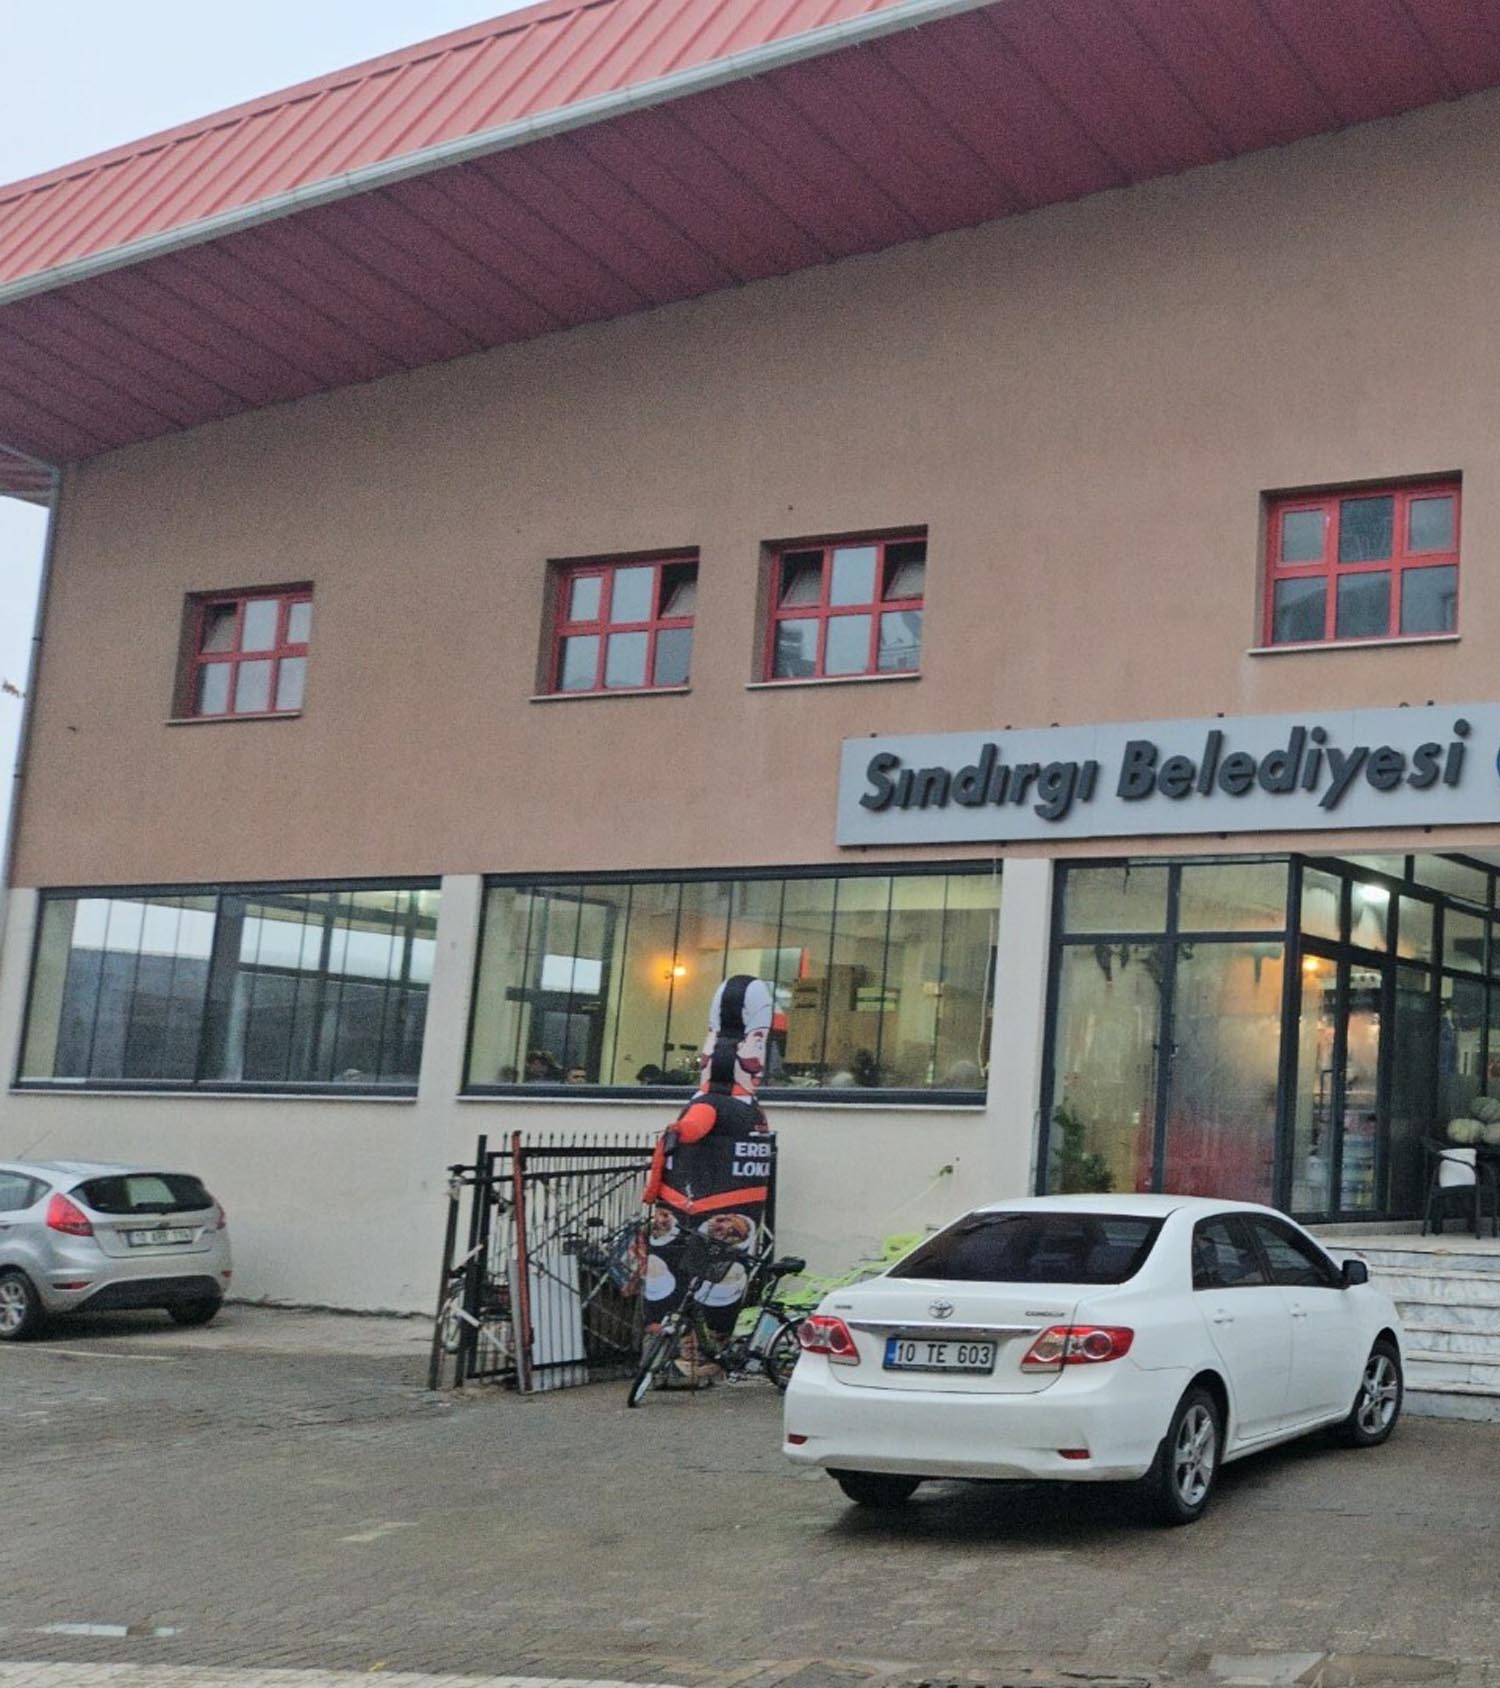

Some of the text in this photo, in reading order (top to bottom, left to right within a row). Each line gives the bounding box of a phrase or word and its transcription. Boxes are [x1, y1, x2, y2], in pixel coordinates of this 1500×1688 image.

[859, 718, 1472, 822] Sındırgı Belediyesi
[897, 1342, 990, 1365] 10 TE 603
